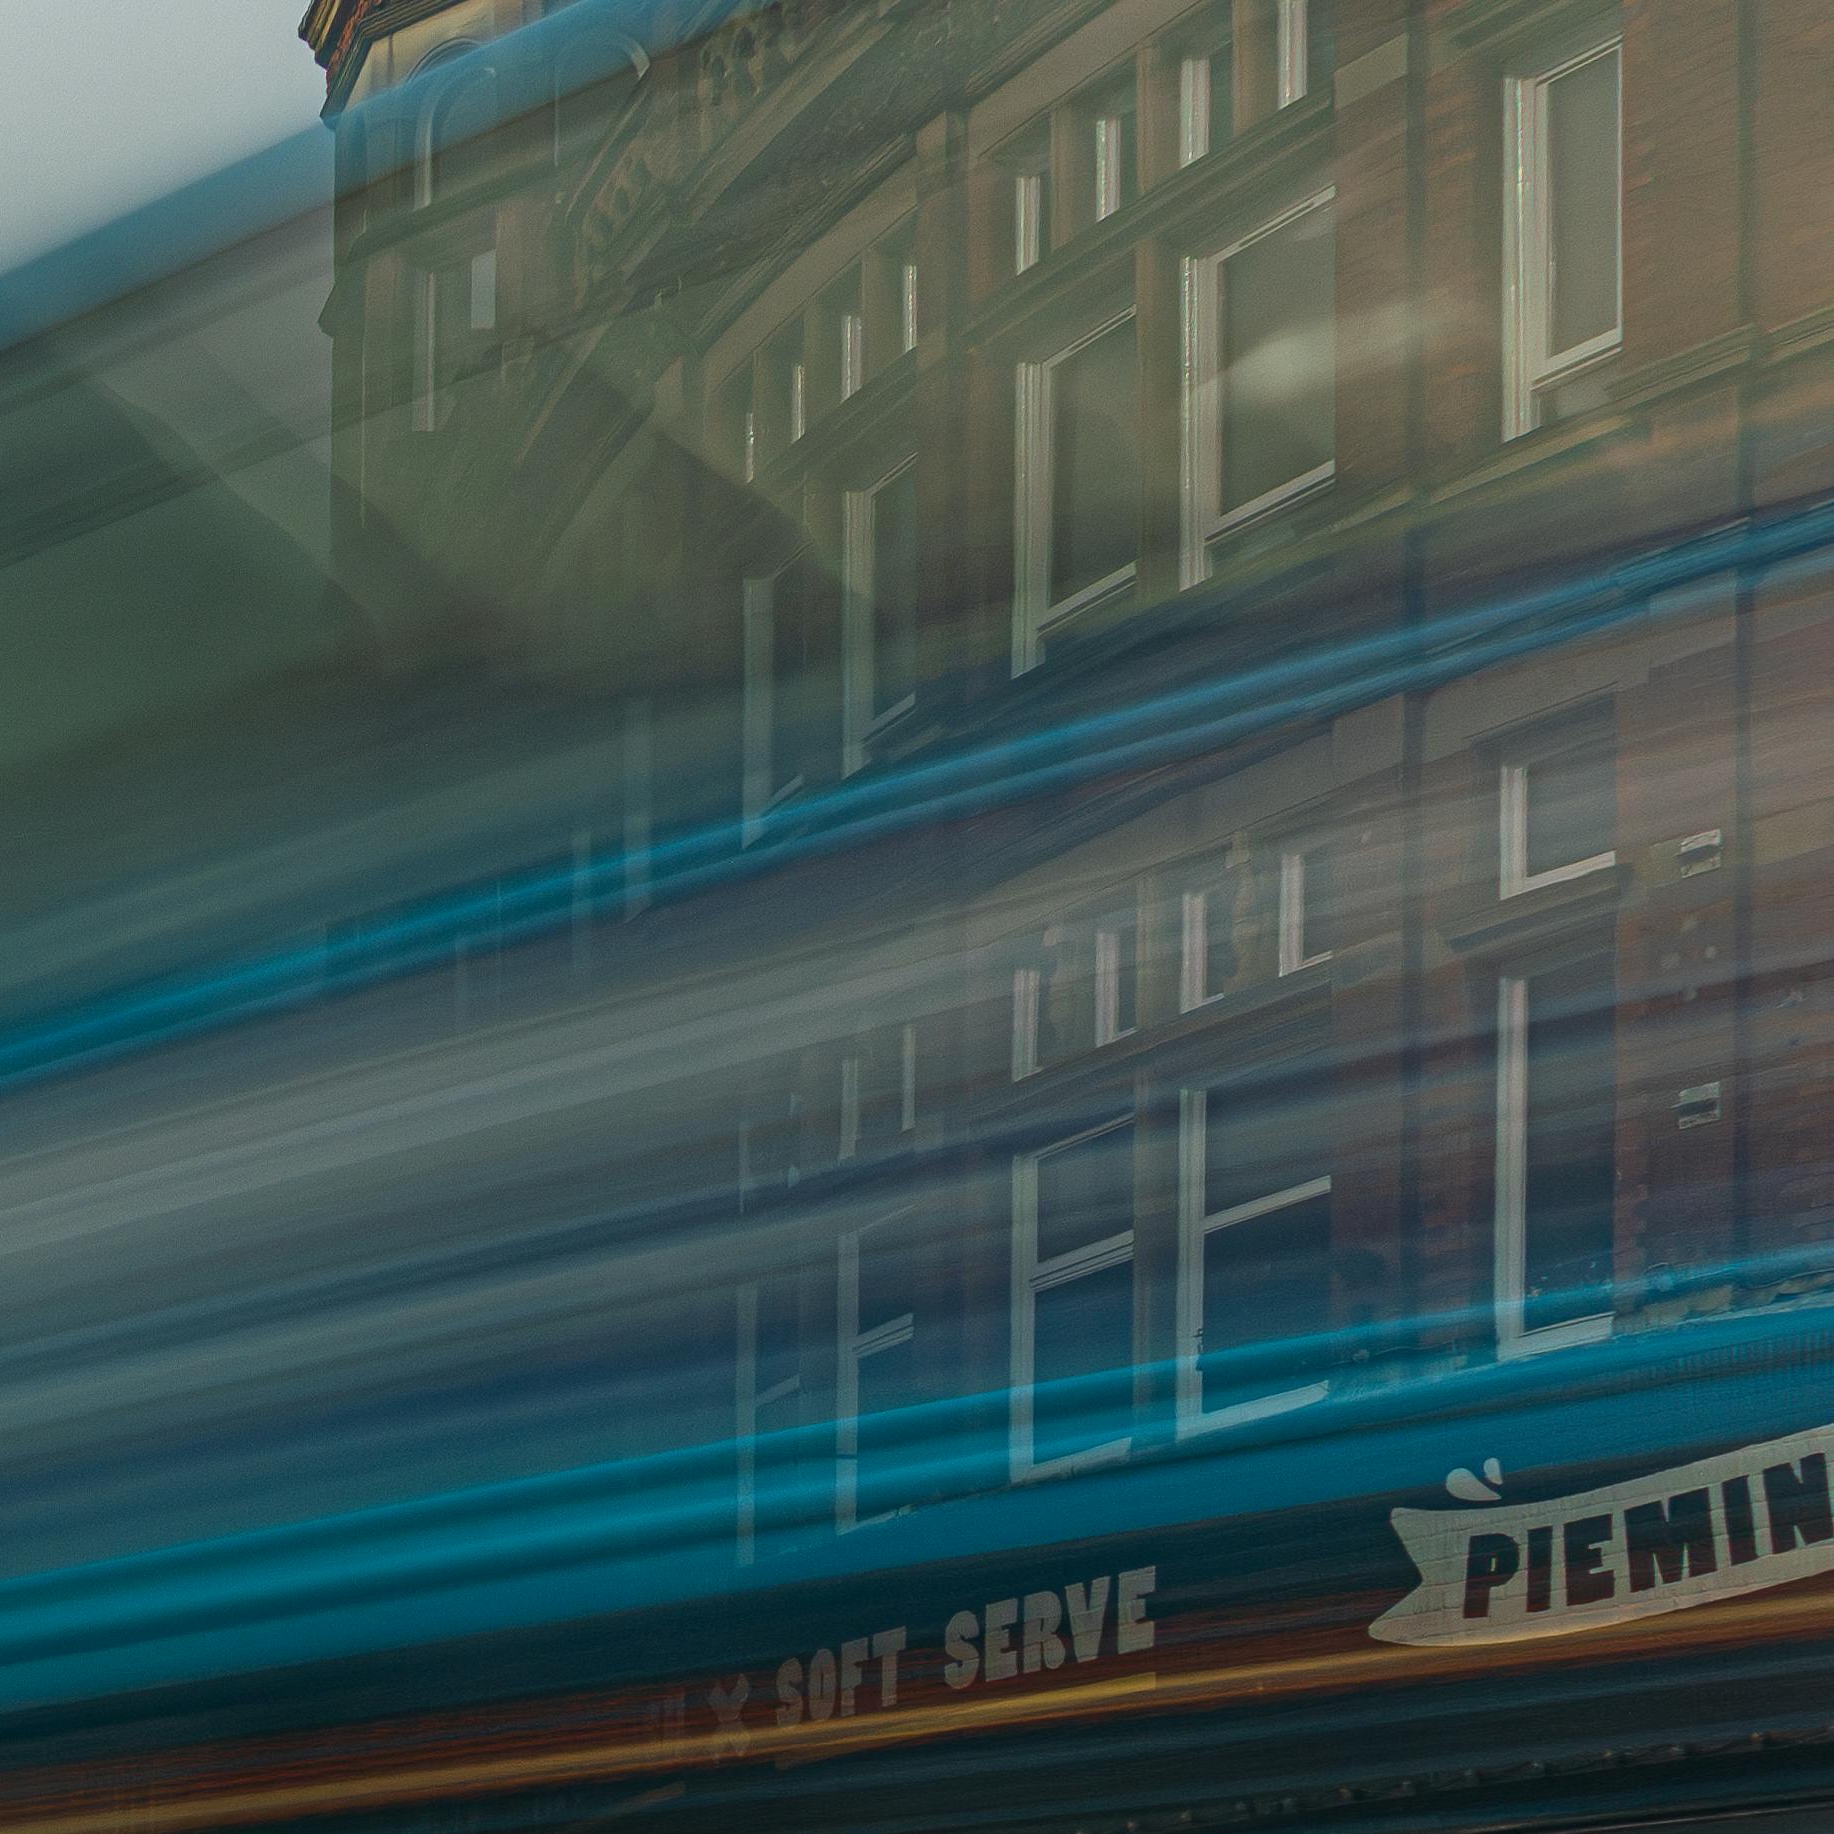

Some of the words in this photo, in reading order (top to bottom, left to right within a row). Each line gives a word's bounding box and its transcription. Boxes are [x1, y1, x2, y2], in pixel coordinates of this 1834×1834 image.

[1464, 1453, 1834, 1618] PIEMIN
[775, 1626, 907, 1727] SOFT
[944, 1566, 1156, 1690] SERVE
